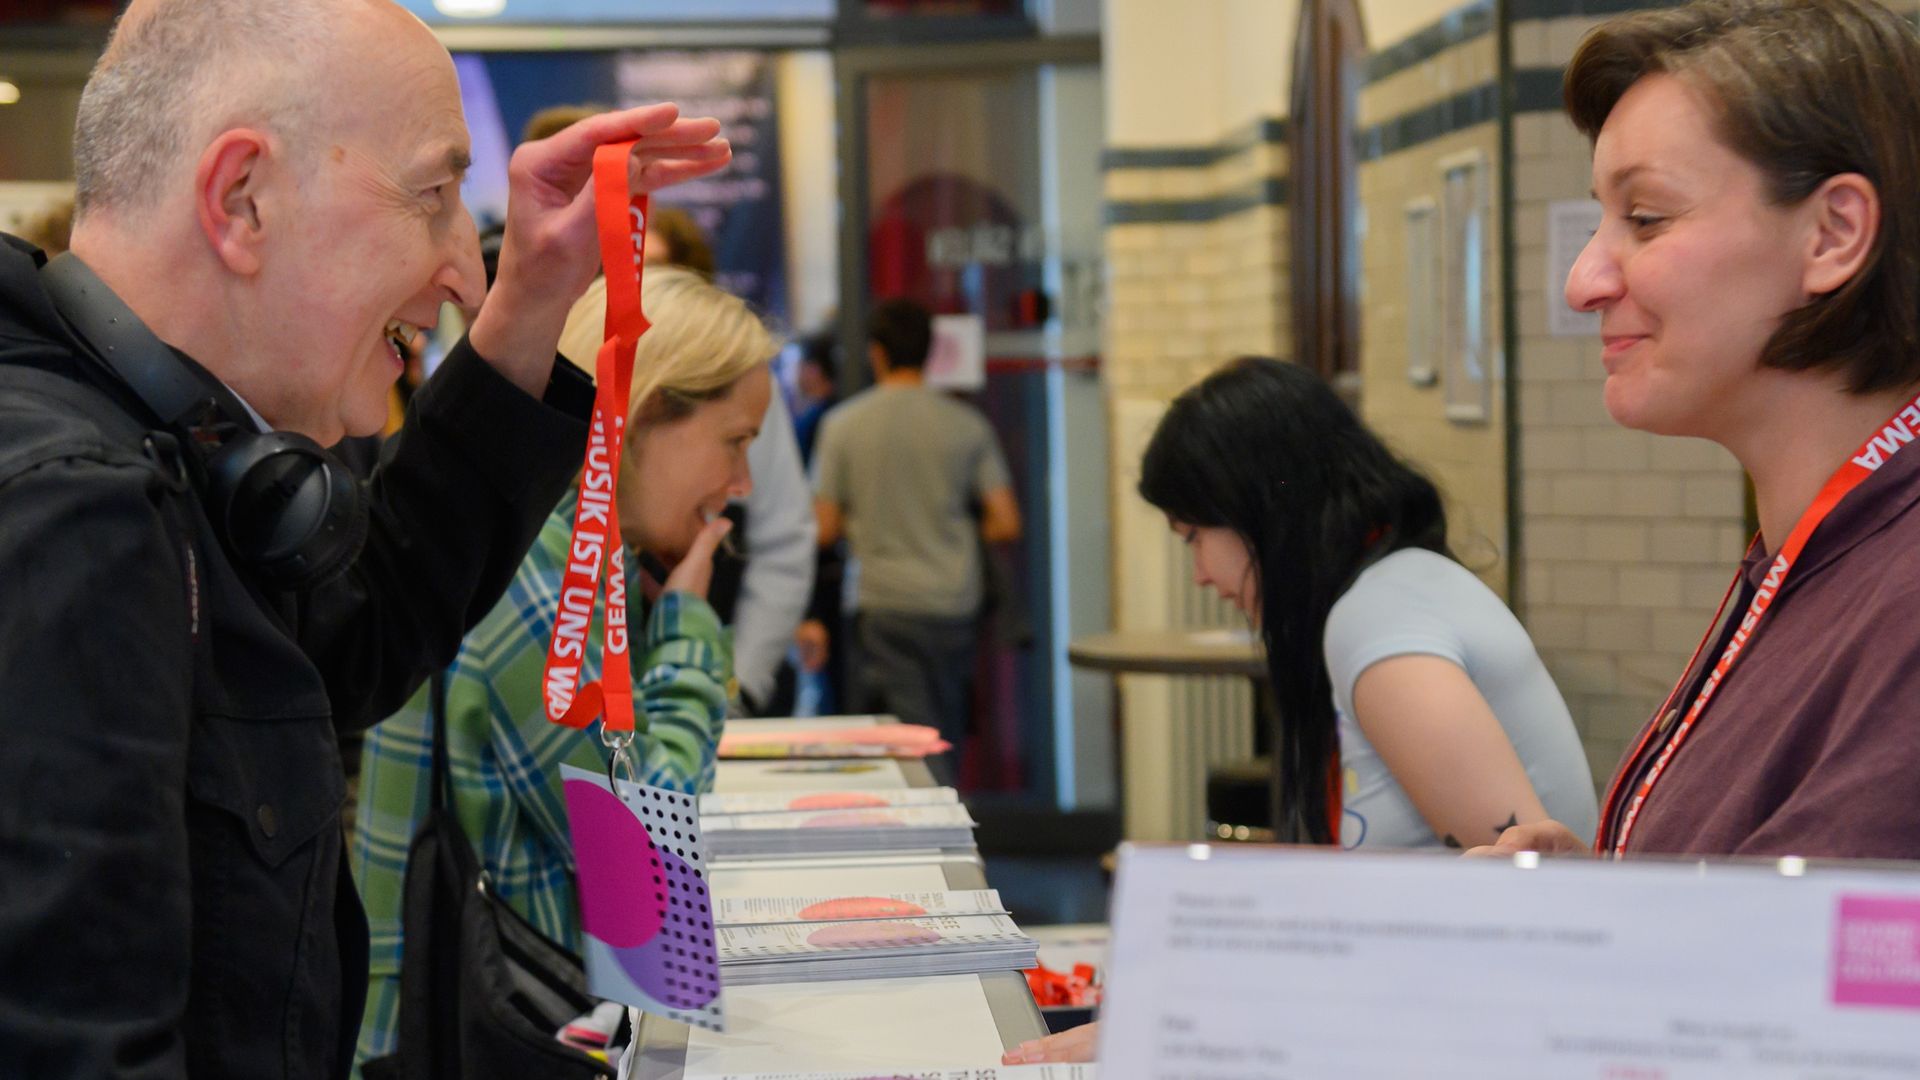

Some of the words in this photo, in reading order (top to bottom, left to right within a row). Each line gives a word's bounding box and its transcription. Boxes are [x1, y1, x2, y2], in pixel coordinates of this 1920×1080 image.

[1852, 397, 1920, 471] EMA
[570, 530, 604, 583] IST
[554, 585, 593, 659] UNS
[607, 543, 628, 655] GEMA
[1721, 554, 1789, 665] MUSIK
[1692, 669, 1721, 717] IST
[1645, 721, 1689, 785] UNS
